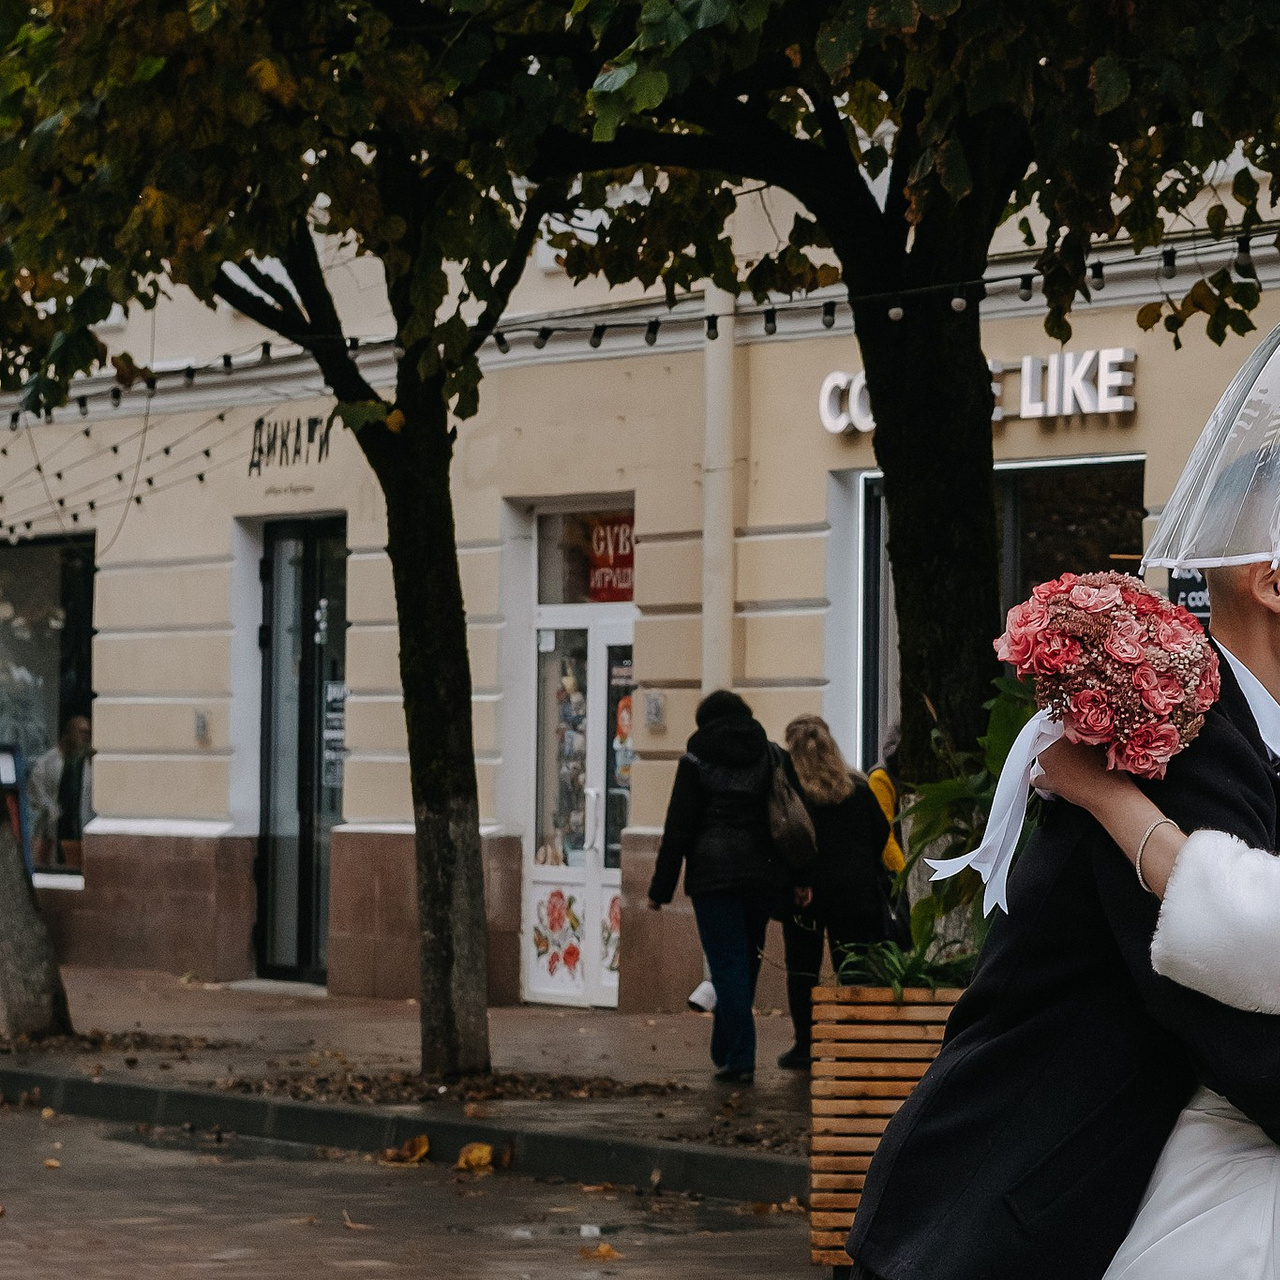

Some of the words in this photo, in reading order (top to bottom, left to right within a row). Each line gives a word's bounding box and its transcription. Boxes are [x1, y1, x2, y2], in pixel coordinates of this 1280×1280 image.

[1019, 347, 1137, 419] LIKE
[248, 417, 331, 477] ДИКАРИ
[592, 523, 634, 566] СУВ
